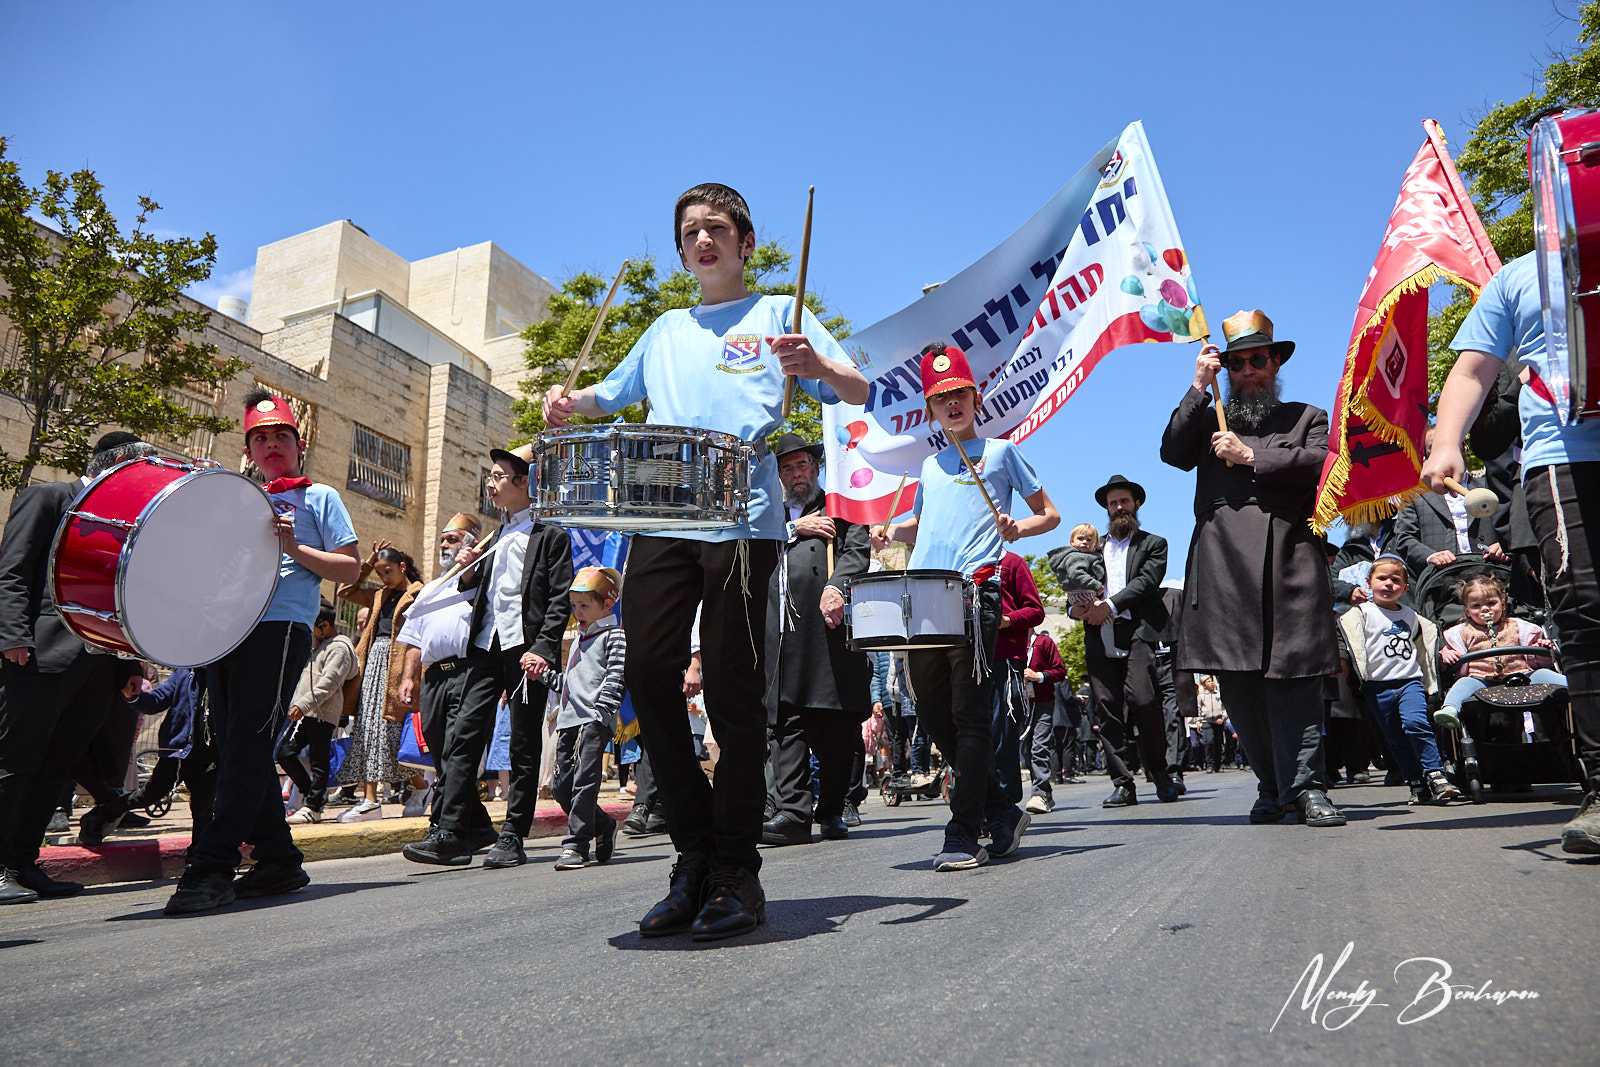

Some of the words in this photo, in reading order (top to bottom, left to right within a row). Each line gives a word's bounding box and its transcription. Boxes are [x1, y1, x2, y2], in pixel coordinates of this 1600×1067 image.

[1030, 246, 1068, 286] ל
[952, 284, 1031, 352] ילדי
[1009, 346, 1043, 374] לכבוד
[1051, 348, 1073, 372] רבי
[991, 368, 1050, 419] שמעון
[1055, 366, 1084, 408] רמת
[1008, 398, 1053, 444] שלמה
